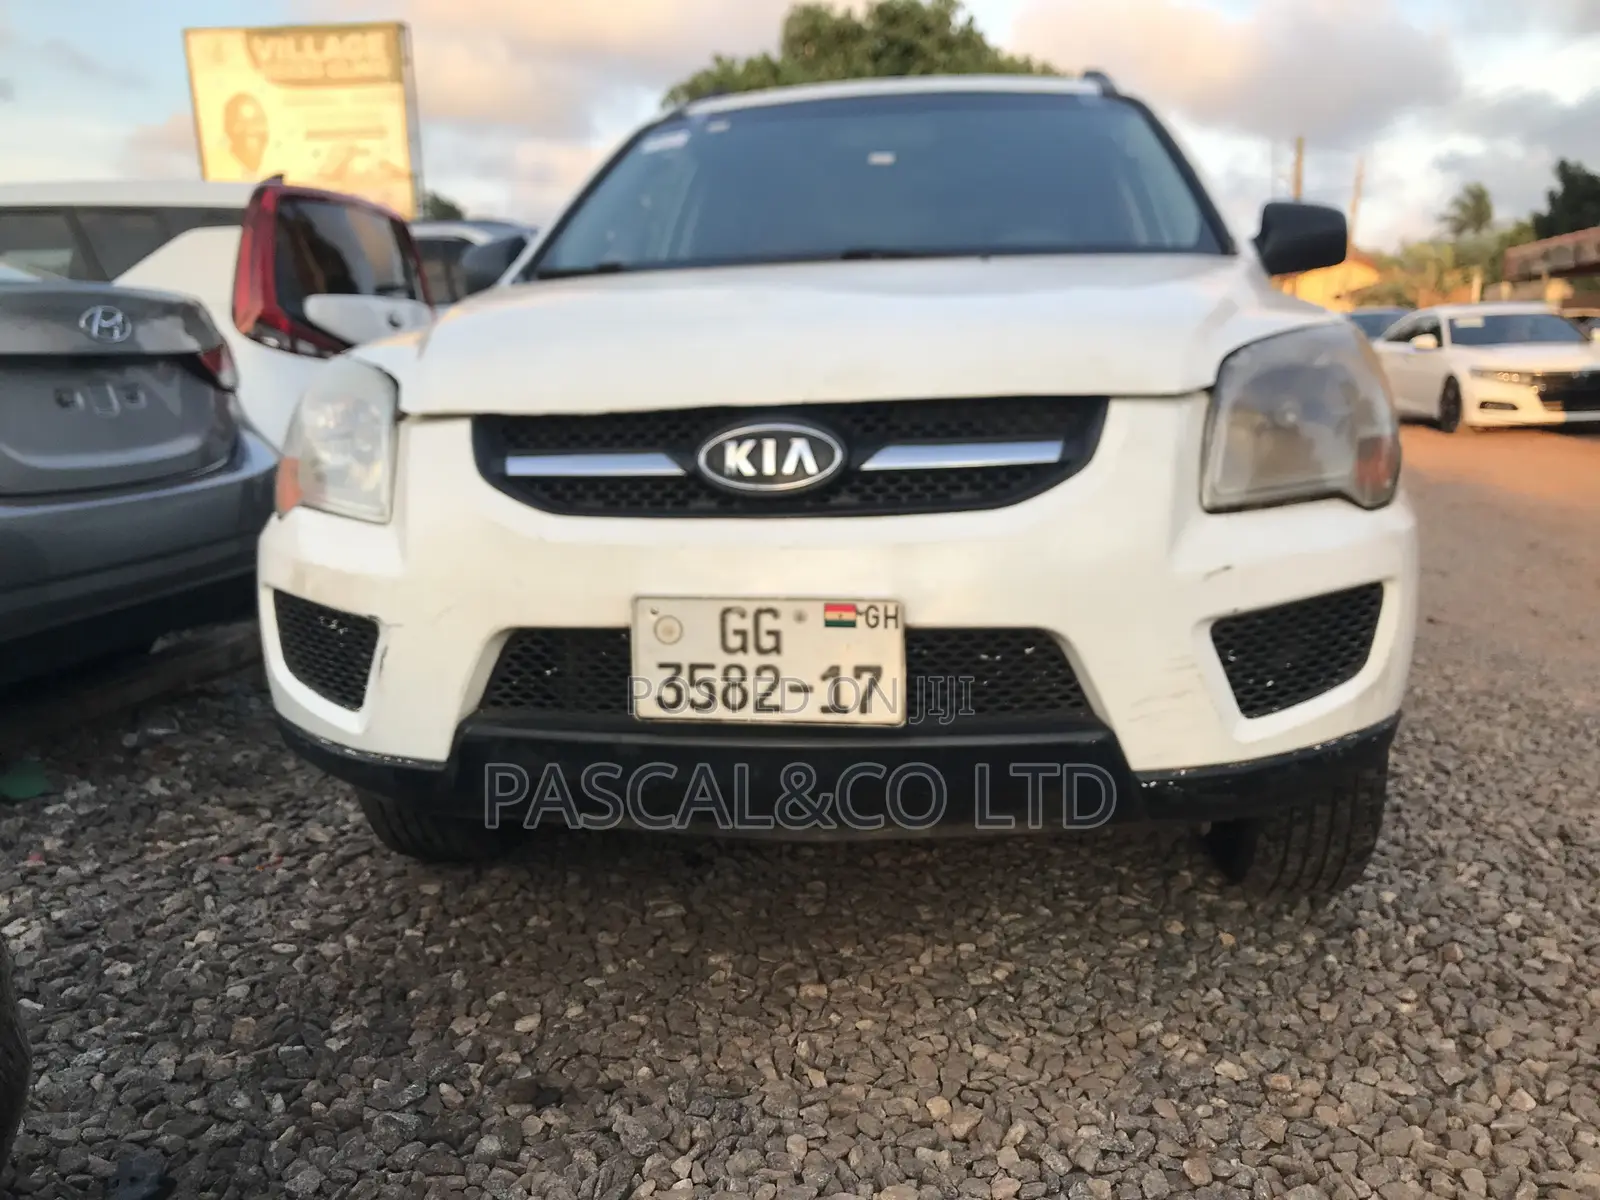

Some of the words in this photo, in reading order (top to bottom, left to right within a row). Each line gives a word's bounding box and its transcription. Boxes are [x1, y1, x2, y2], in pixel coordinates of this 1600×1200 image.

[251, 32, 386, 60] VILLAGE
[723, 437, 820, 476] KIA
[719, 606, 782, 655] GG
[864, 605, 899, 629] GH
[655, 662, 883, 715] 3582-17
